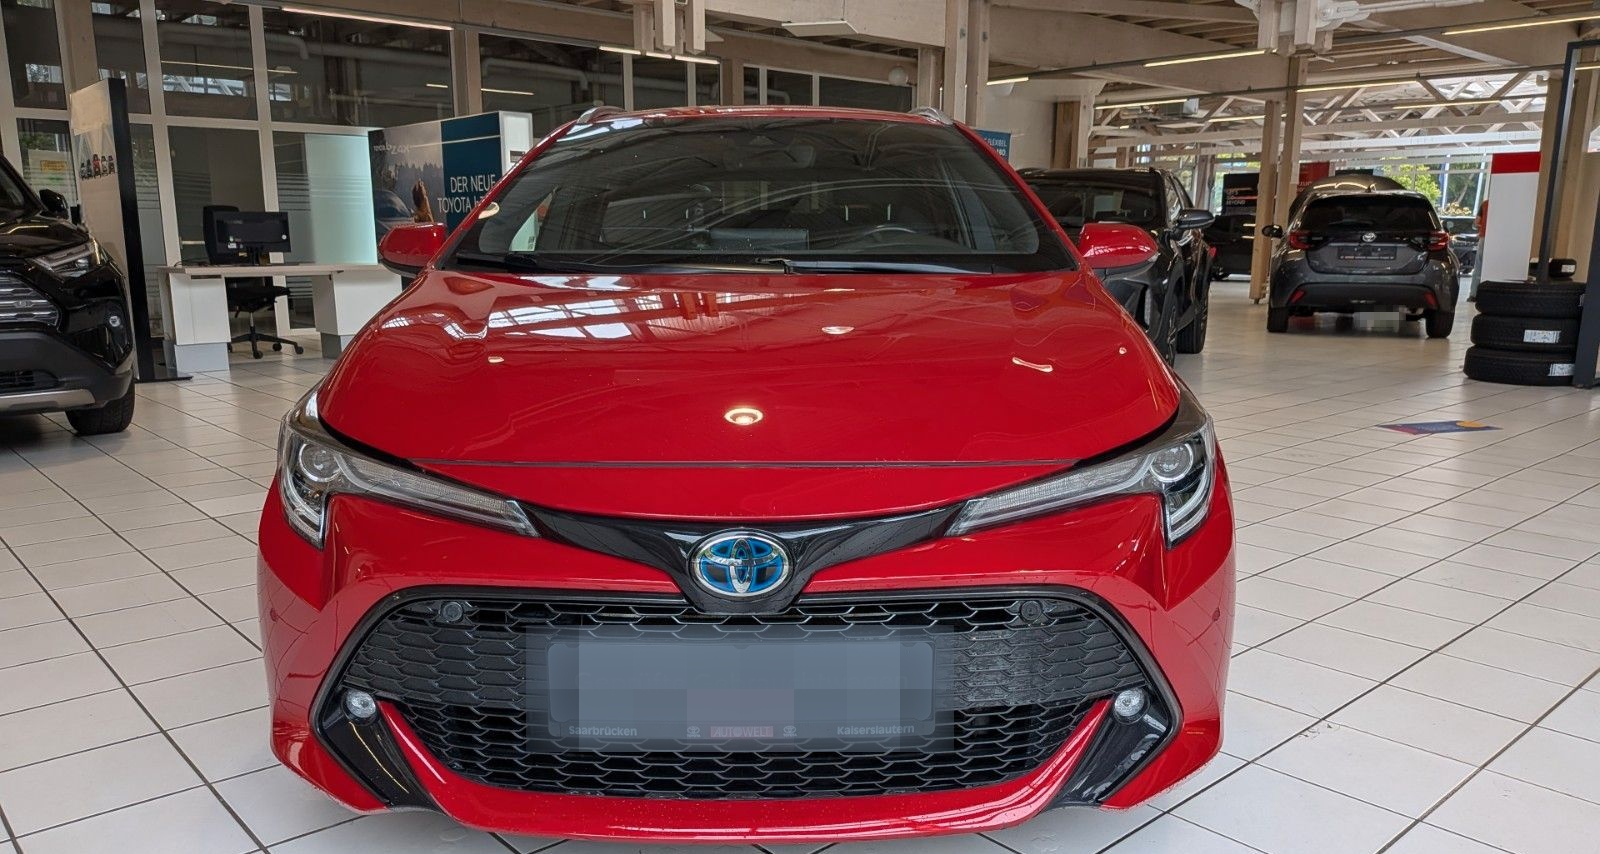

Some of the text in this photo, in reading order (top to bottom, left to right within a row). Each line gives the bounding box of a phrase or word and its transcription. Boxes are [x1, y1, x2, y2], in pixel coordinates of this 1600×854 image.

[450, 174, 496, 193] DER NEUE
[437, 195, 472, 213] TOYOTA
[568, 726, 638, 737] Saarbrücken
[837, 724, 915, 736] Kaiserslautern
